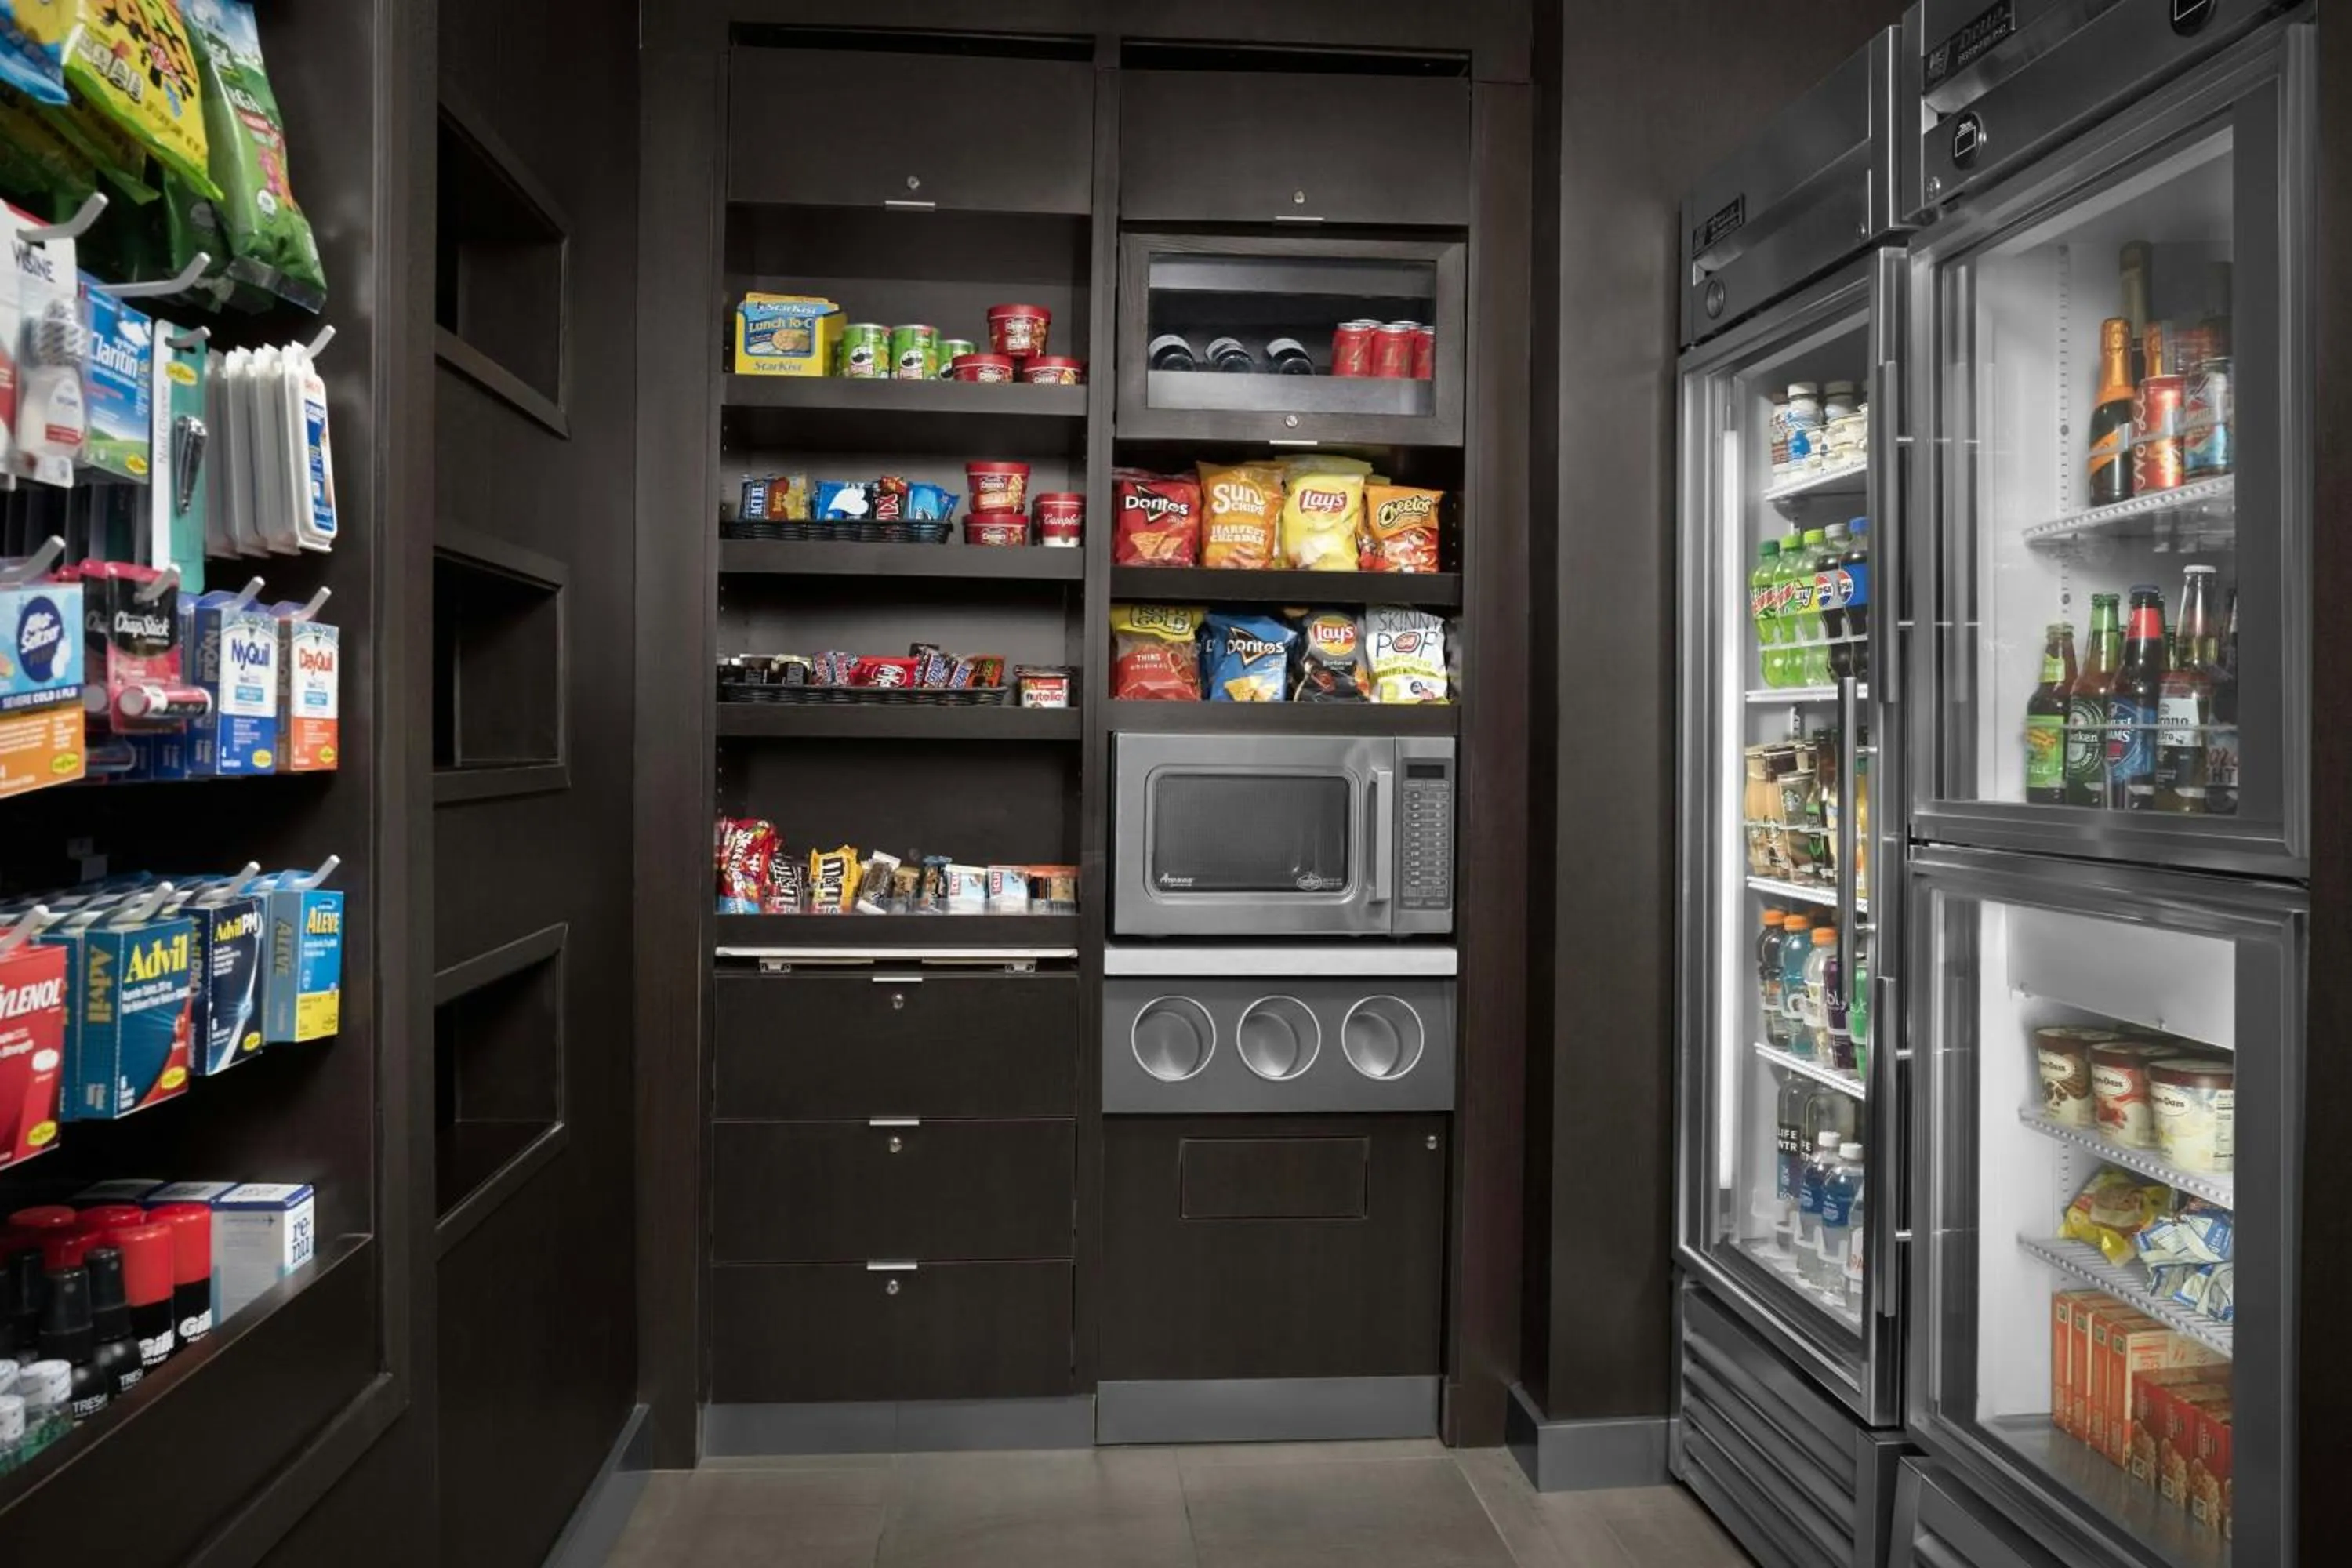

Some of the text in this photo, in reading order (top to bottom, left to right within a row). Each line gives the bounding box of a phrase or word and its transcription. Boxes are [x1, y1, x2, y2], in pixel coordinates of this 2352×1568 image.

[748, 317, 786, 333] Lunch
[1124, 495, 1189, 516] Doritos
[1377, 495, 1434, 528] Cheetos
[114, 610, 170, 638] ChapStick
[1137, 615, 1187, 626] GOLD
[1377, 611, 1443, 632] SKINNY
[231, 638, 270, 670] NyQuil
[1226, 638, 1286, 655] Doritos
[1376, 630, 1437, 658] POP
[299, 647, 333, 676] DayQuil
[33, 689, 55, 704] COLD
[306, 906, 339, 935] ALEVE
[124, 934, 188, 984] Advil
[88, 943, 114, 1023] Advil
[0, 977, 63, 1021] YLENOL
